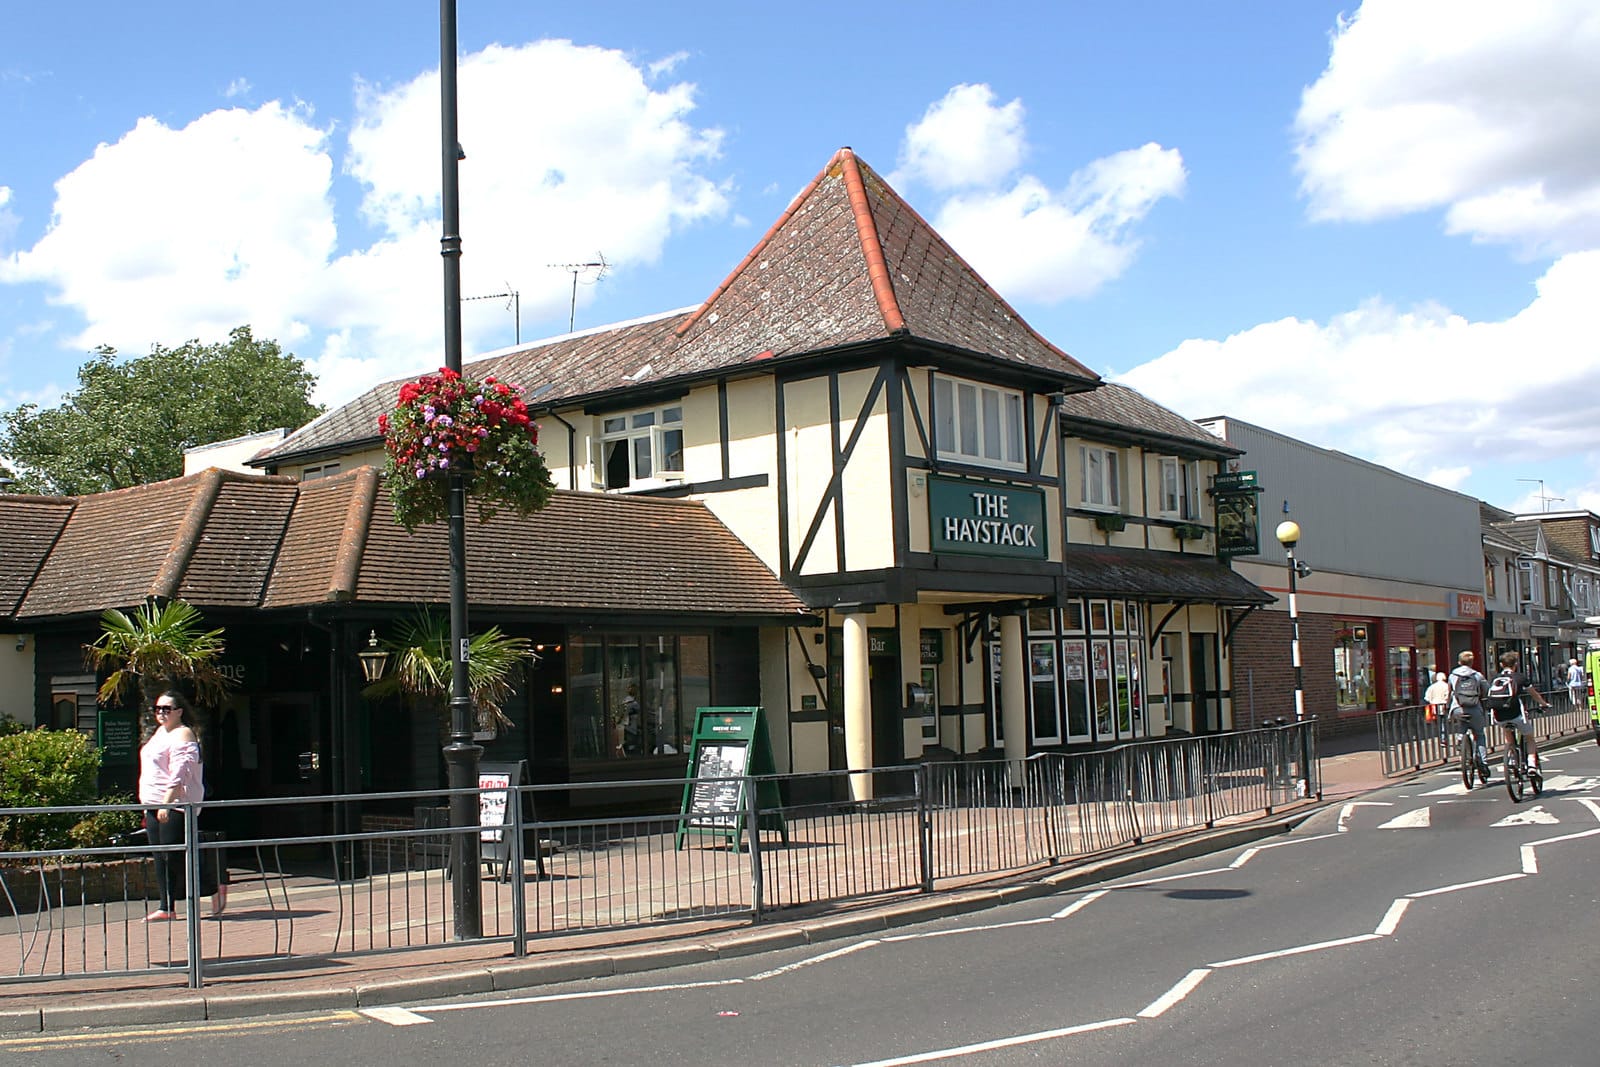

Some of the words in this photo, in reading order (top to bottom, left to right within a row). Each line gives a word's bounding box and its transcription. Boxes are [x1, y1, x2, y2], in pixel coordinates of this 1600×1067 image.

[973, 493, 1009, 518] THE
[944, 517, 1037, 547] HAYSTACK
[1460, 598, 1481, 615] Iceland
[870, 637, 886, 651] Bar
